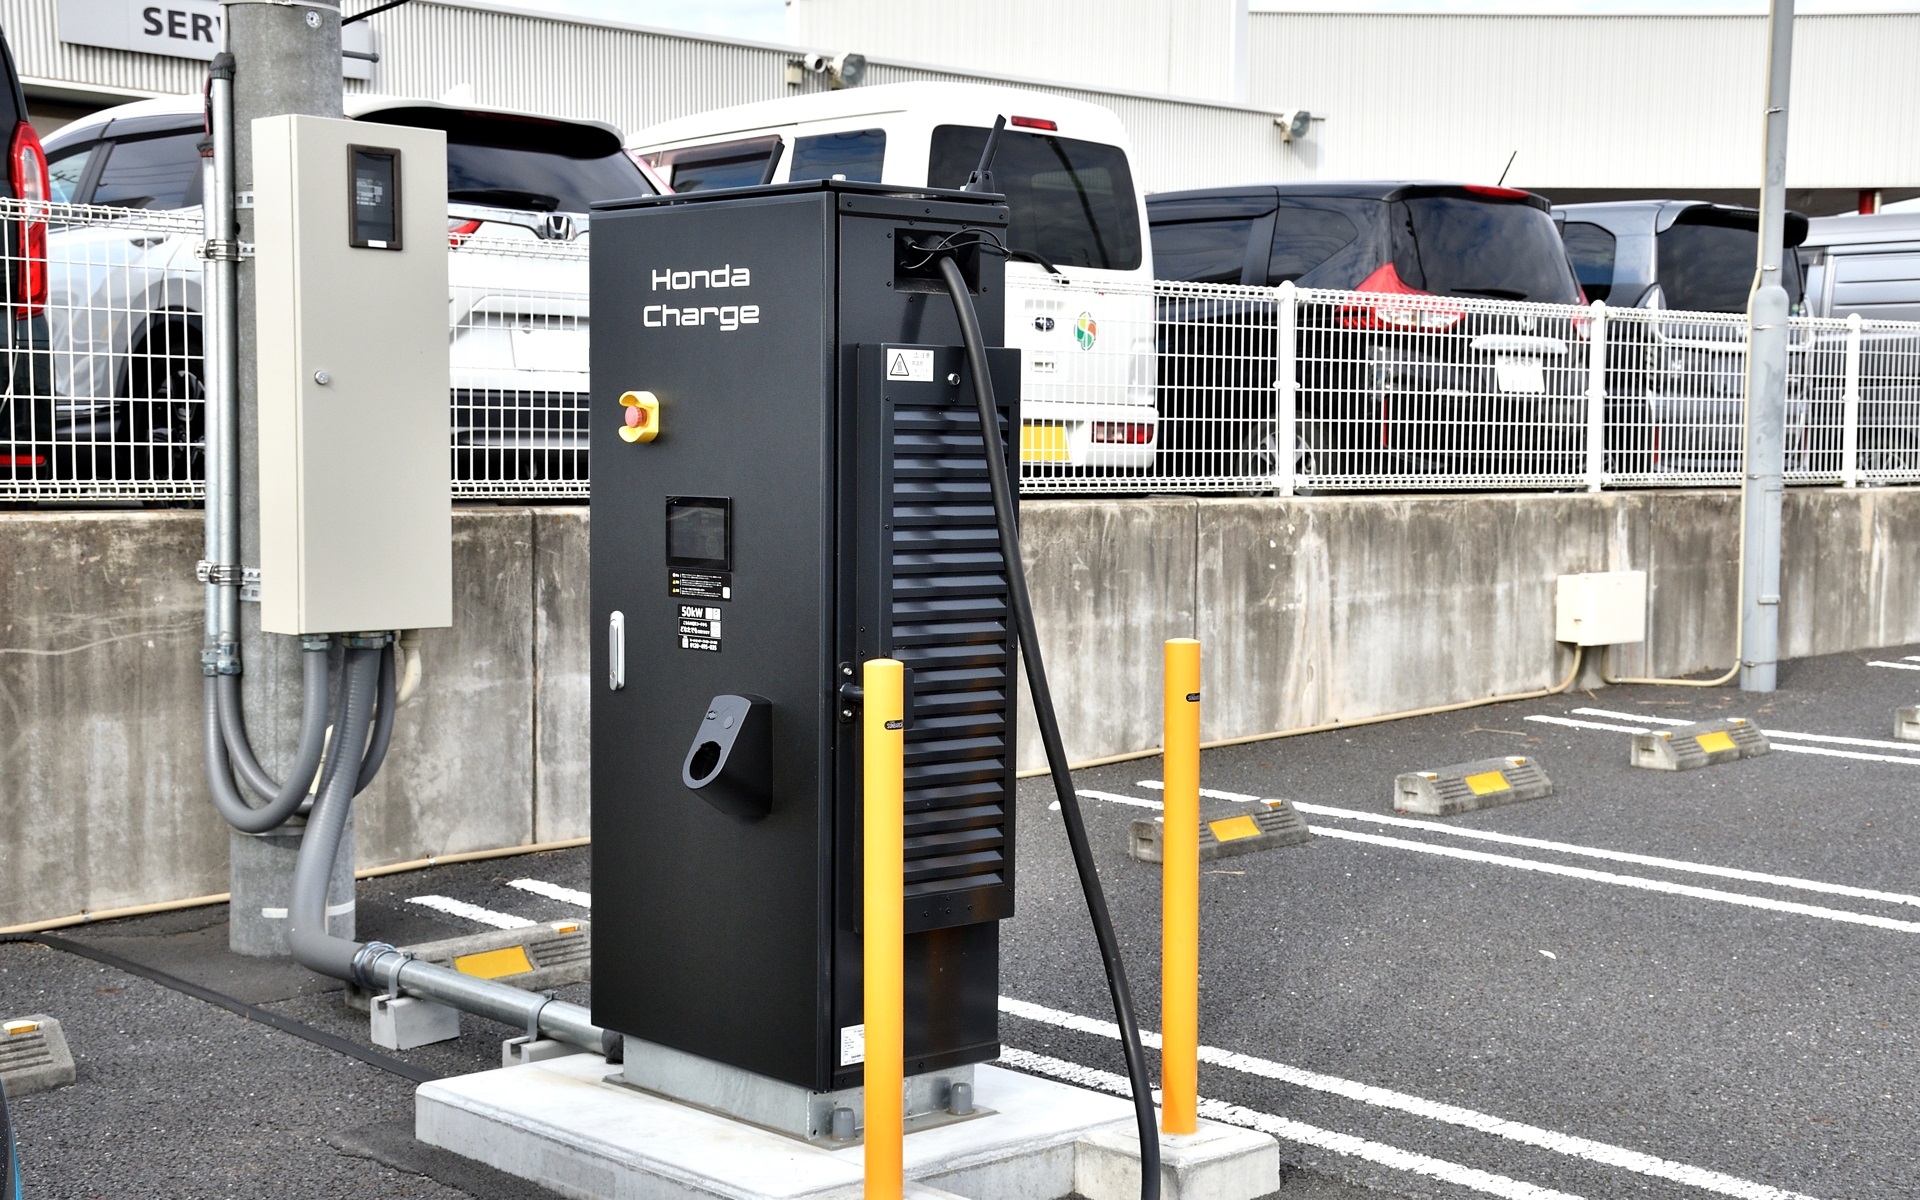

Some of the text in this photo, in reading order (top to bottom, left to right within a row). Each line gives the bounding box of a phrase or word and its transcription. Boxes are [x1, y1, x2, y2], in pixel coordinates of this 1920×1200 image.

[143, 7, 221, 43] SER
[651, 264, 750, 291] Honda
[643, 304, 760, 331] Charge
[681, 606, 703, 618] 50kW
